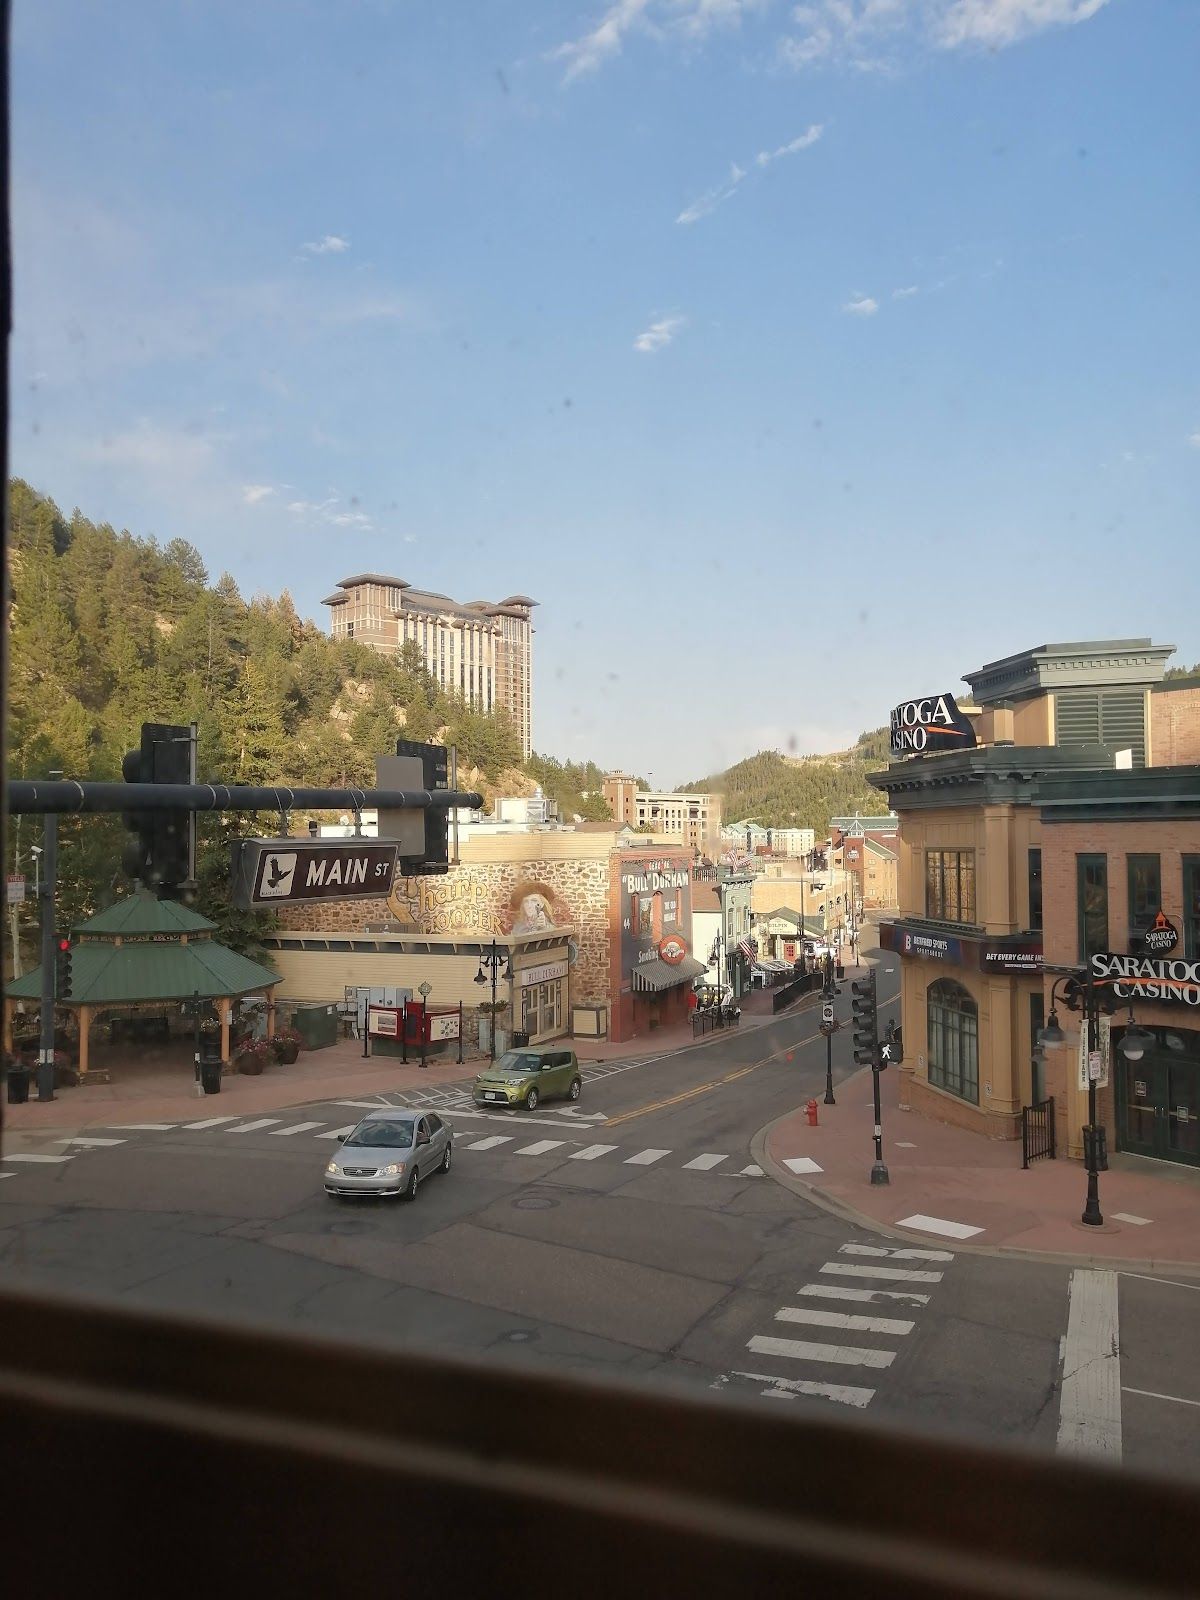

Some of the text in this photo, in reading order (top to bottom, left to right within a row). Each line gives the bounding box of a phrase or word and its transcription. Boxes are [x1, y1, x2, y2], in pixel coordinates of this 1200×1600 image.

[305, 857, 390, 887] MAIN ST
[652, 871, 689, 891] DURHAM
[1145, 930, 1178, 944] SARATOGA
[932, 939, 948, 951] SPORTS
[1150, 939, 1172, 950] CASINO
[985, 953, 998, 961] BET
[997, 953, 1017, 961] EVERY
[1016, 953, 1034, 961] GAME
[1113, 977, 1200, 1006] CASINO
